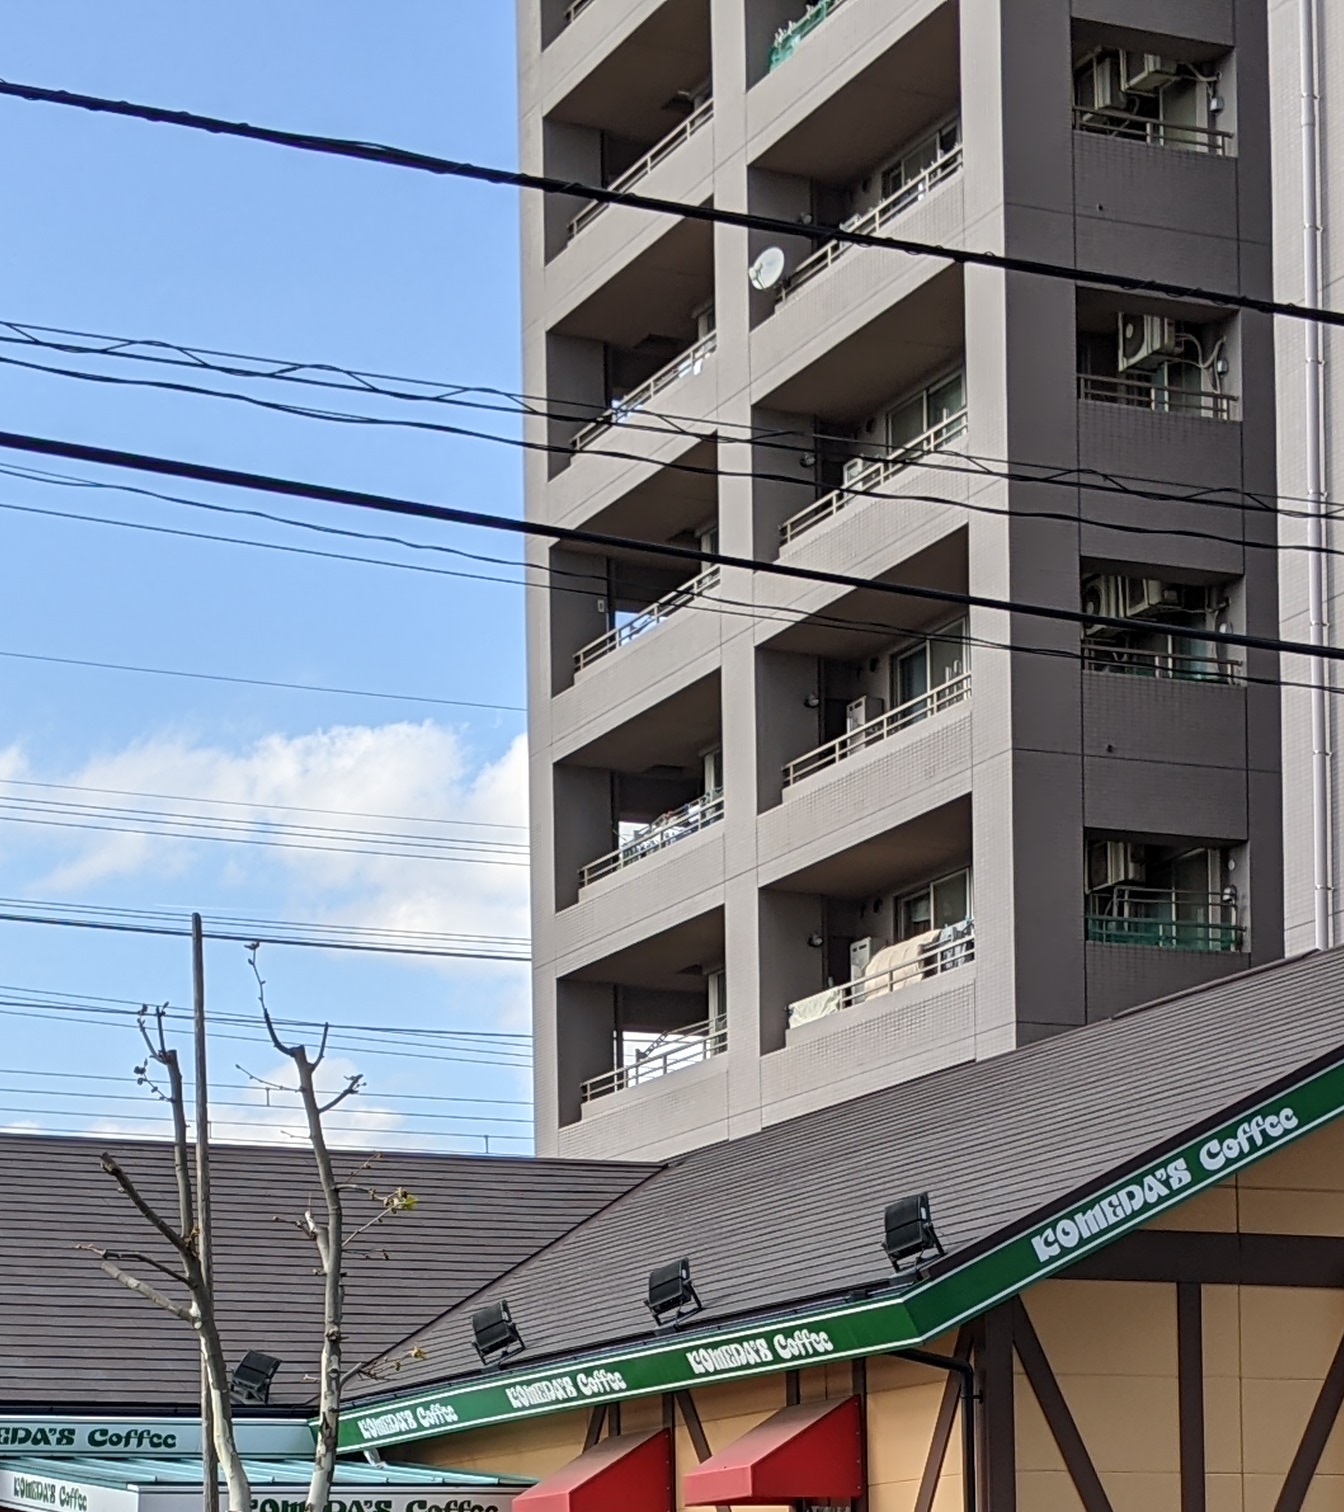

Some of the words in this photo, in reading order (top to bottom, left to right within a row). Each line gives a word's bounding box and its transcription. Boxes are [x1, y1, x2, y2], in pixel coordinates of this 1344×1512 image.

[1031, 1157, 1192, 1263] KOMEDA'S
[1198, 1106, 1299, 1171] Coffee
[685, 1336, 774, 1375] KOMEDA'S
[773, 1328, 834, 1360] Coffee
[506, 1376, 577, 1408] KOMEDA'S
[576, 1368, 627, 1396] Coffee
[87, 1428, 178, 1449] Coffee
[358, 1408, 416, 1440] KOMEDA'S
[415, 1402, 459, 1429] Coffee
[13, 1476, 57, 1505] KOMEDA'S
[58, 1486, 88, 1512] Coffee
